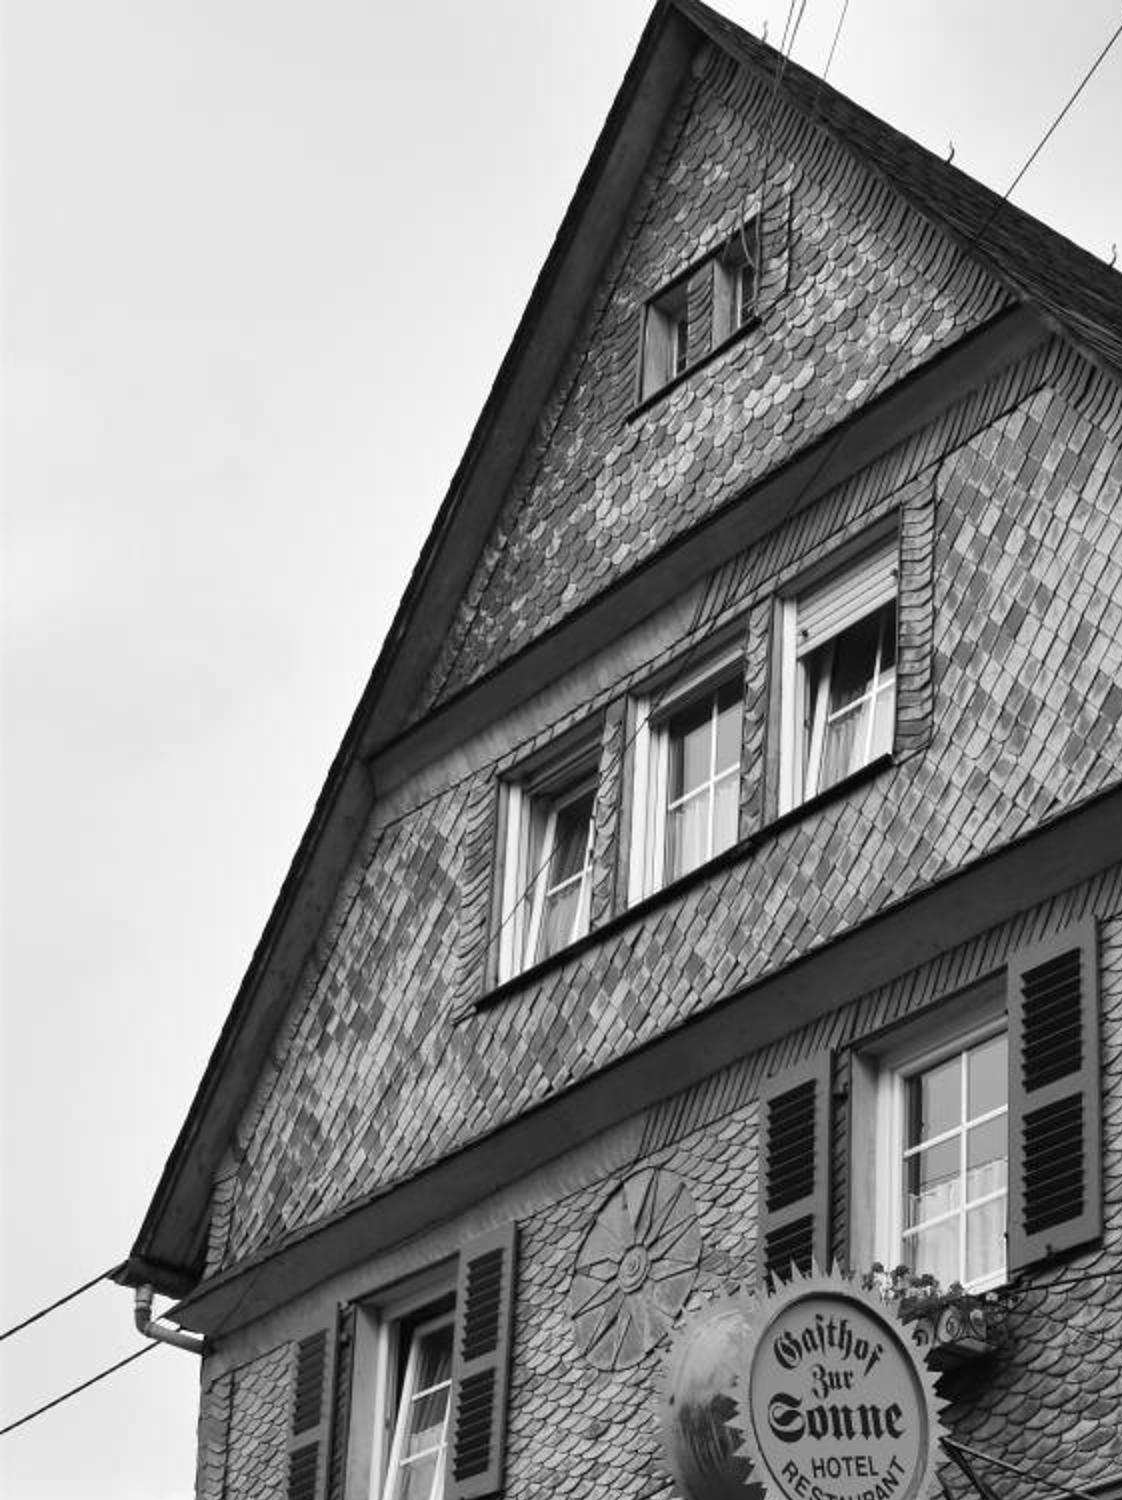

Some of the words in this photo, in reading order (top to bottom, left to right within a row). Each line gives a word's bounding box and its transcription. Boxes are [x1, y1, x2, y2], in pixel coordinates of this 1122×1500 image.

[811, 1364, 854, 1399] Zur
[768, 1392, 905, 1443] Sonne
[811, 1455, 879, 1479] HOTEL
